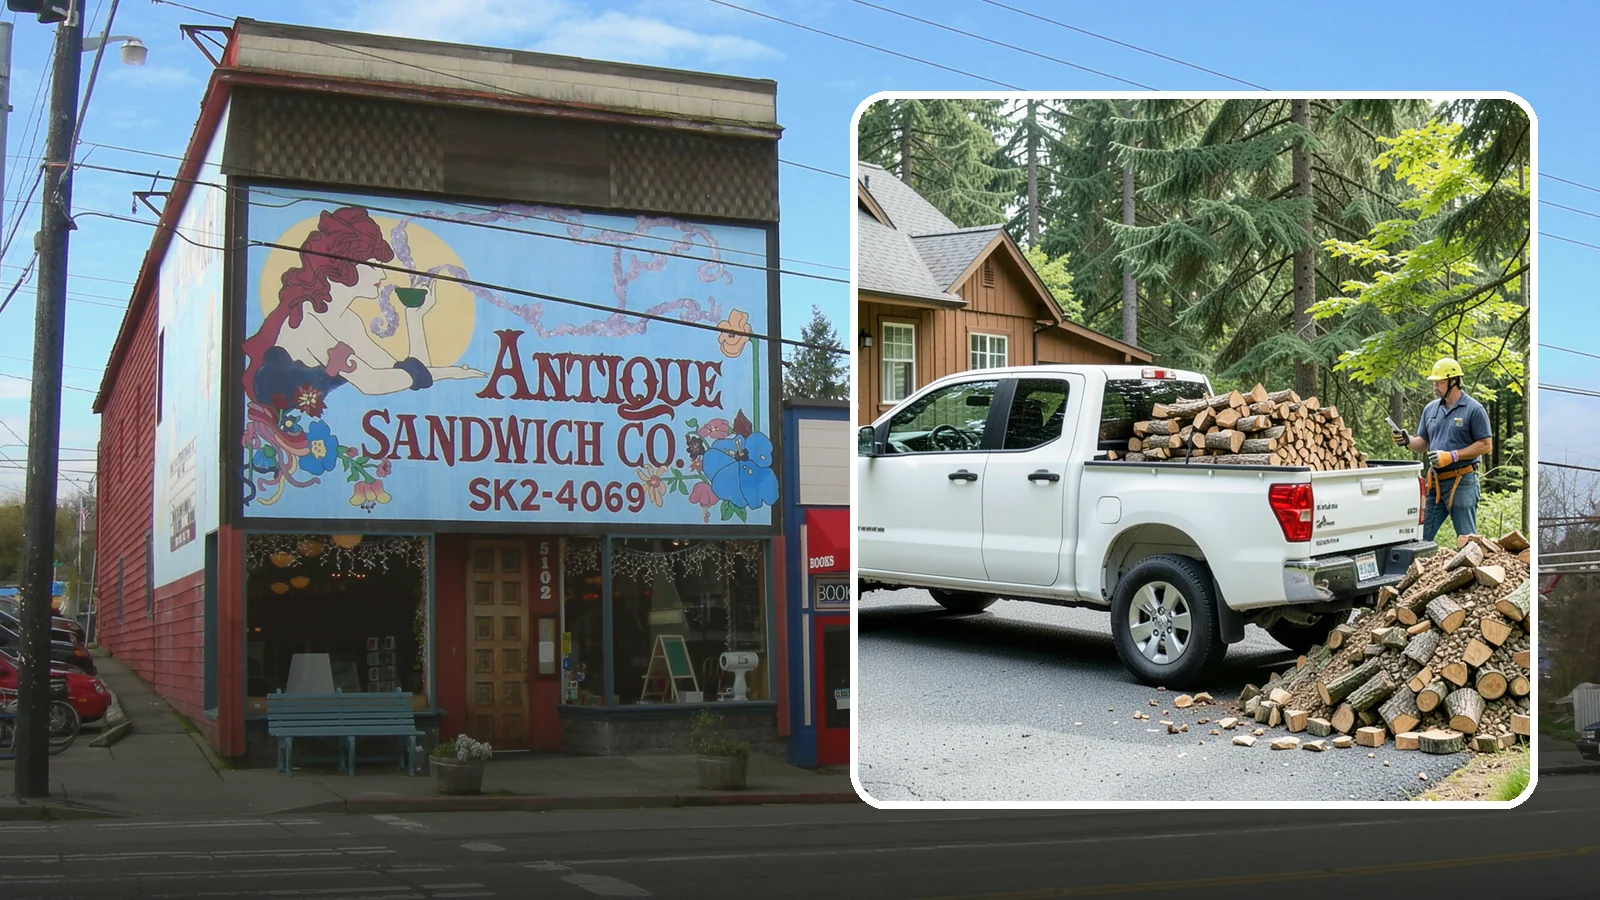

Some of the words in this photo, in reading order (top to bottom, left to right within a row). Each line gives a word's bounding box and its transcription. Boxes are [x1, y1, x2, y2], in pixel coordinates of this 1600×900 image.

[475, 329, 724, 420] ANTIQUE
[361, 408, 605, 467] SANDWICH
[617, 422, 685, 469] CO.
[468, 477, 646, 513] SK2-4069
[540, 542, 551, 599] 5102
[809, 555, 834, 568] BOOKS
